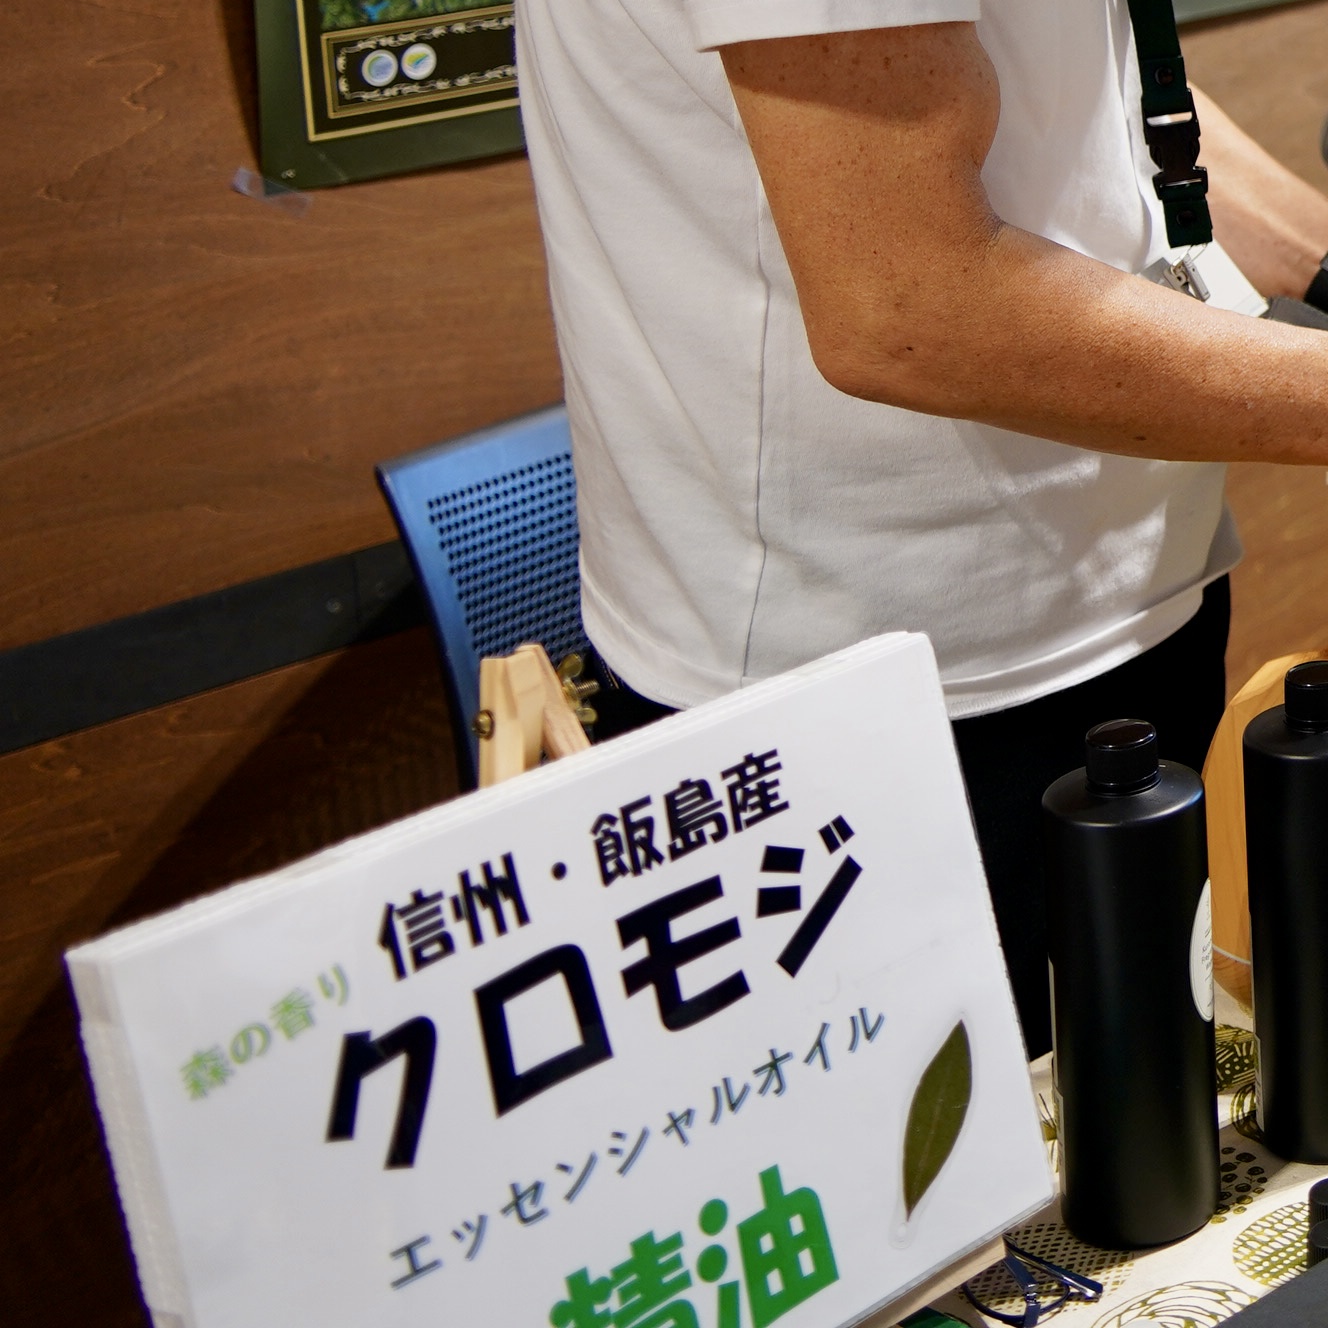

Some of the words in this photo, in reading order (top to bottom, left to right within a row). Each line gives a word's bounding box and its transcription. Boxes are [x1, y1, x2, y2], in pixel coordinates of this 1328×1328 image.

[325, 814, 864, 1170] クロモジ
[377, 749, 792, 982] 信州・飯島産
[180, 963, 353, 1102] 森の香り
[388, 1005, 888, 1290] エッセンシャルオイル
